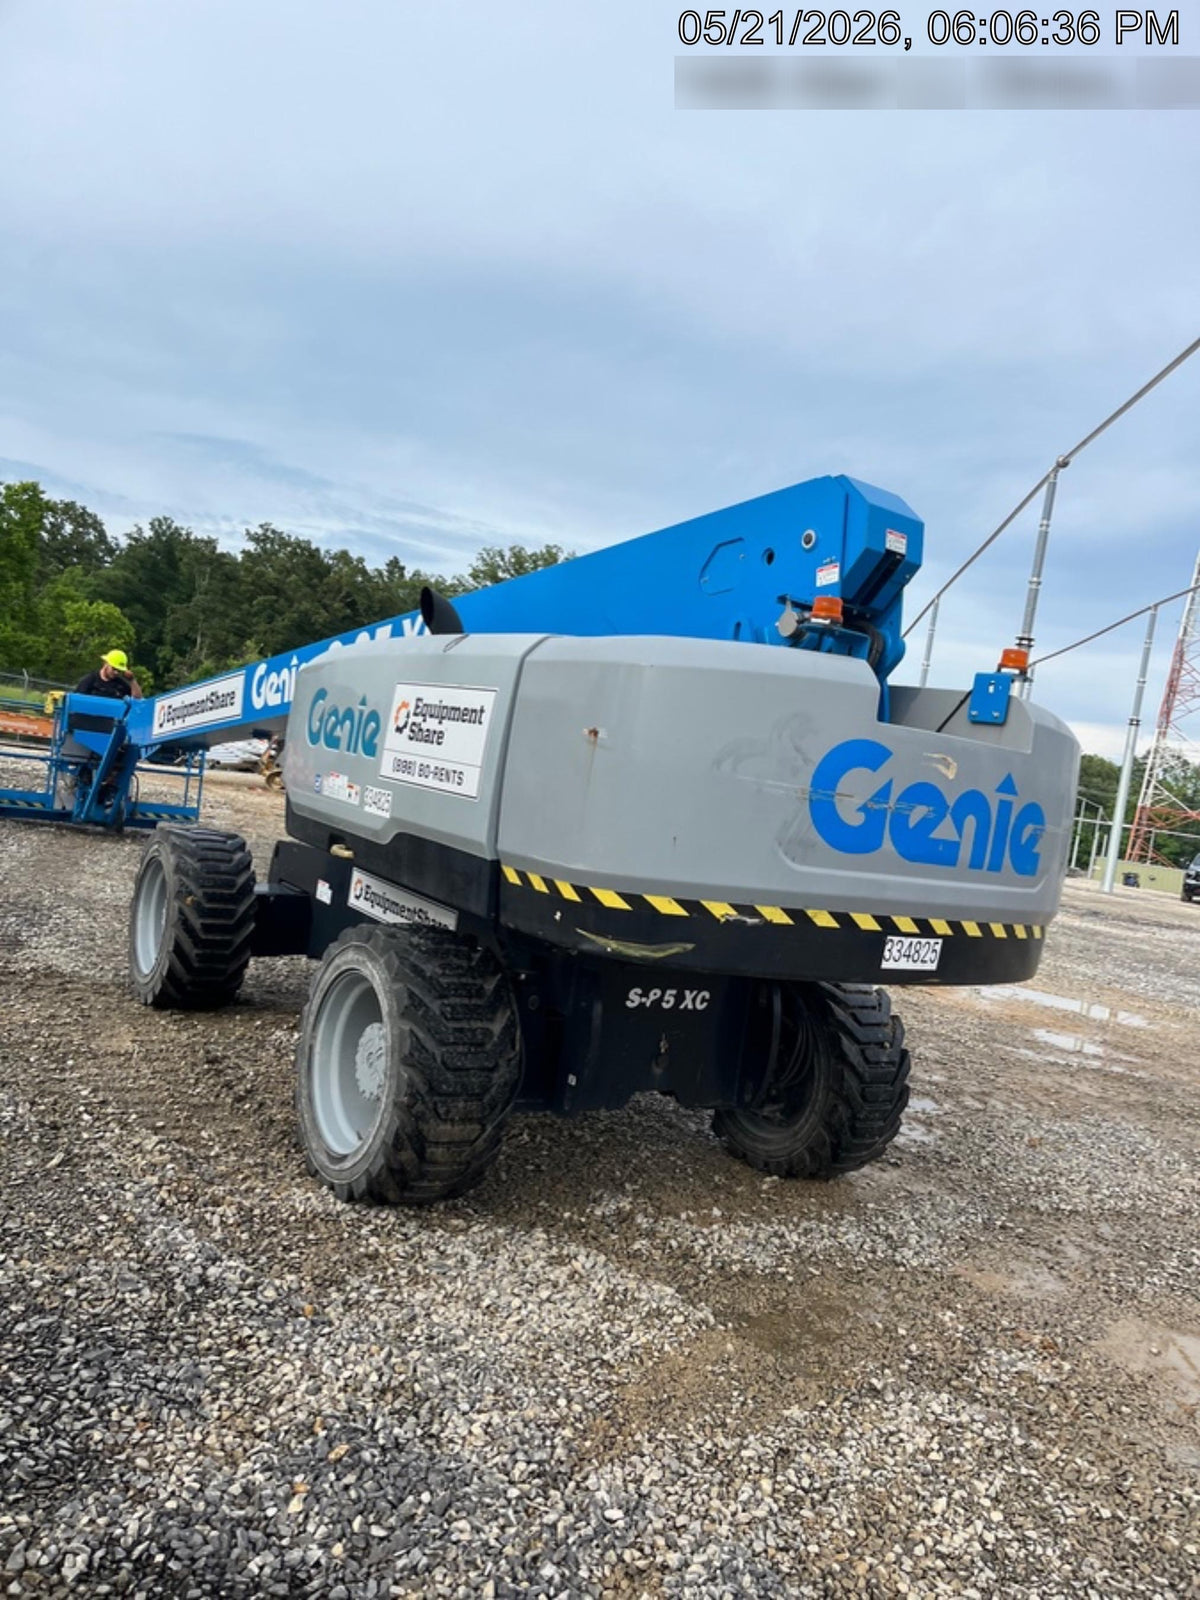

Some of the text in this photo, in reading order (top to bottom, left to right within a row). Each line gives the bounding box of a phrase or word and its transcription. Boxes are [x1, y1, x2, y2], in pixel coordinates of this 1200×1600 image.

[252, 655, 300, 710] Geni
[167, 691, 236, 725] EquipmentShare
[307, 687, 381, 758] Genie
[412, 697, 486, 725] Equipment
[408, 721, 445, 745] Share
[809, 739, 1046, 877] Genie
[882, 938, 940, 965] 334825
[679, 989, 711, 1011] XC
